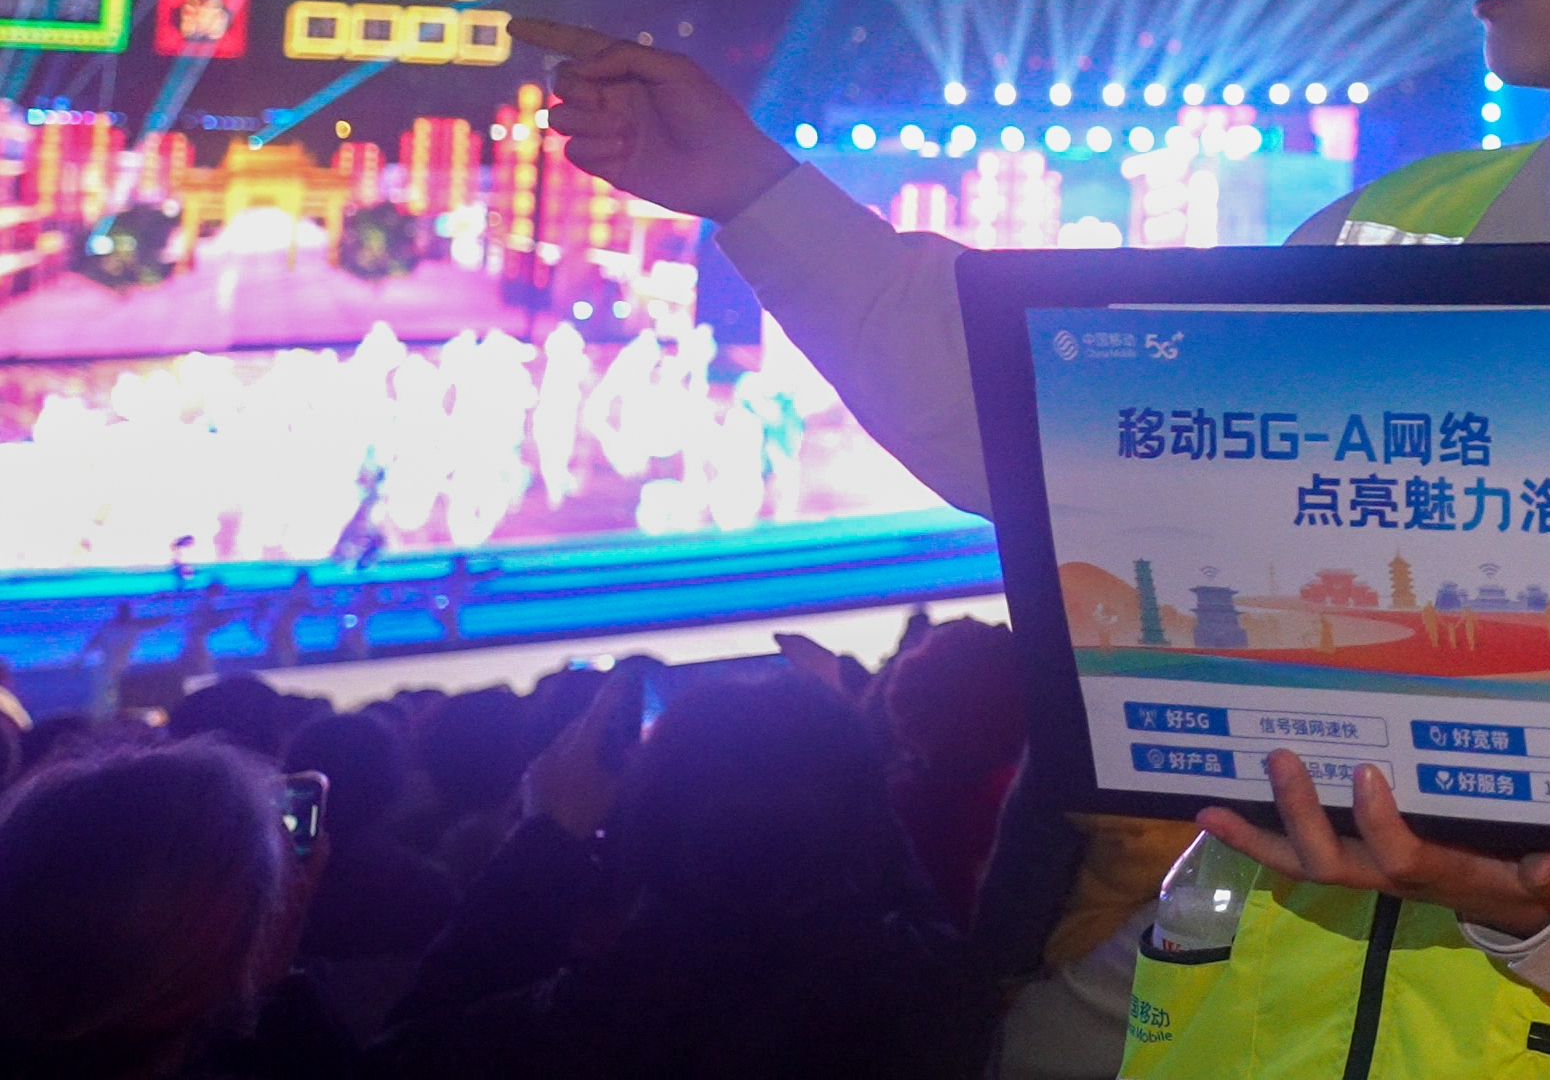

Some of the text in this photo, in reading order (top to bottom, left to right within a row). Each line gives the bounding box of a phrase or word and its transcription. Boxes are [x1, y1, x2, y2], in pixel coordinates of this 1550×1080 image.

[1117, 407, 1492, 466] 移动5G-A网络
[1165, 708, 1360, 740] 好5G 信号强网速快
[1453, 727, 1510, 751] 好宽带
[1168, 751, 1222, 774] 好产品
[1457, 771, 1515, 796] 好服务
